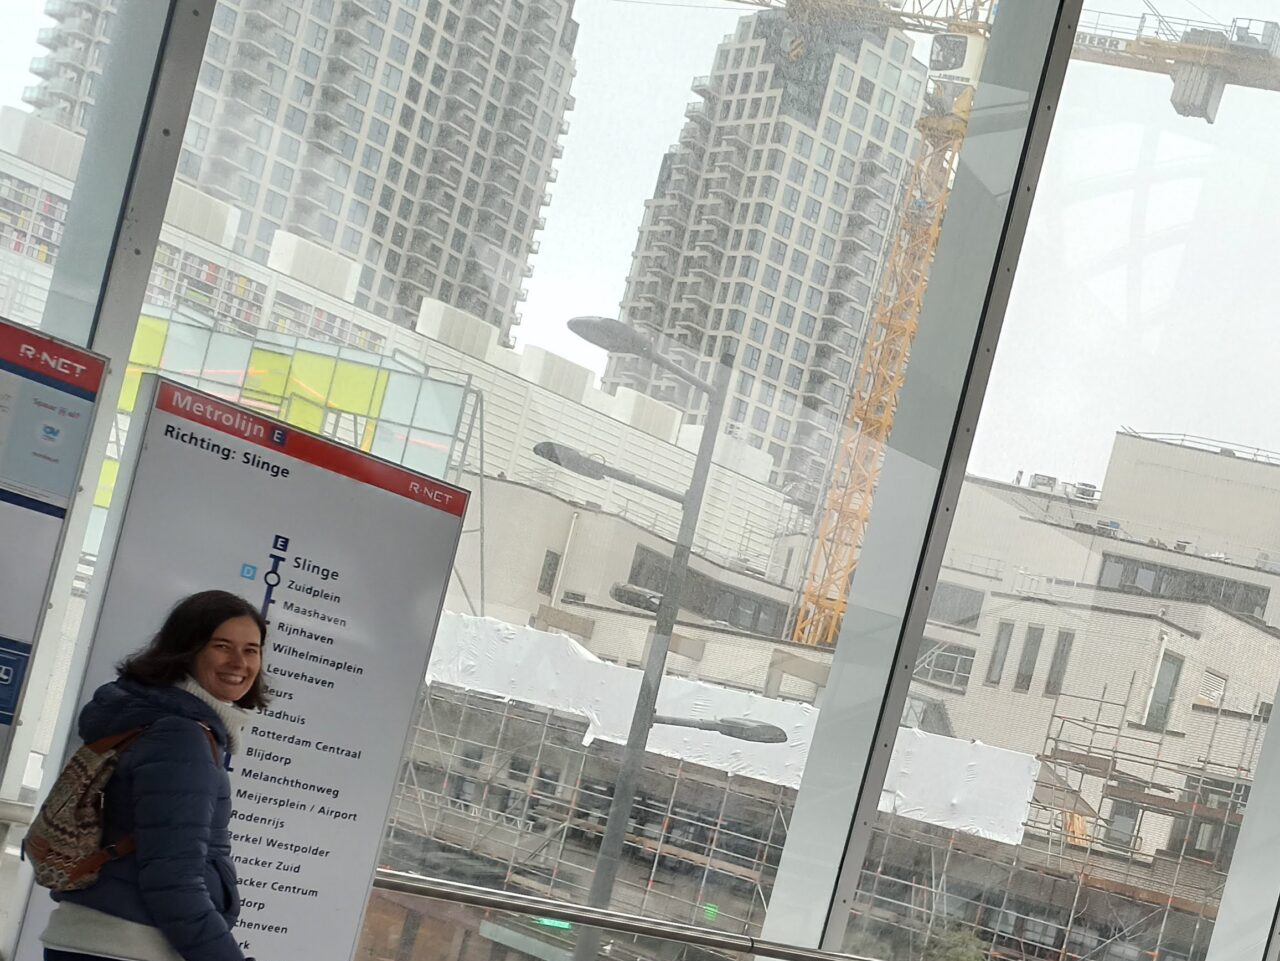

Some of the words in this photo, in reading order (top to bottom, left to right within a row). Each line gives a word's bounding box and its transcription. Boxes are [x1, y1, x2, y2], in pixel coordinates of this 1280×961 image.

[171, 390, 265, 437] Metrolijn
[164, 423, 237, 461] Richting:
[242, 451, 290, 478] Slinge
[293, 556, 340, 581] Slinge
[287, 579, 342, 604] Zuidplein
[282, 600, 347, 627] Maashaven
[277, 622, 335, 646] Rijnhaven
[272, 642, 364, 675] Wilhelminaplein
[266, 663, 335, 689] Leuvehaven
[250, 725, 312, 749] Rotterdam
[315, 741, 362, 760] Centraal
[246, 746, 292, 766] Blijdorp
[240, 767, 340, 799] Melanchthonweg
[235, 788, 307, 812] Meijersplein
[317, 806, 358, 822] Airport
[230, 809, 286, 829] Rodenrijs
[266, 838, 330, 858] Westpolder
[275, 861, 301, 874] Zuid
[270, 881, 319, 898] Centrum
[240, 897, 266, 912] dorp
